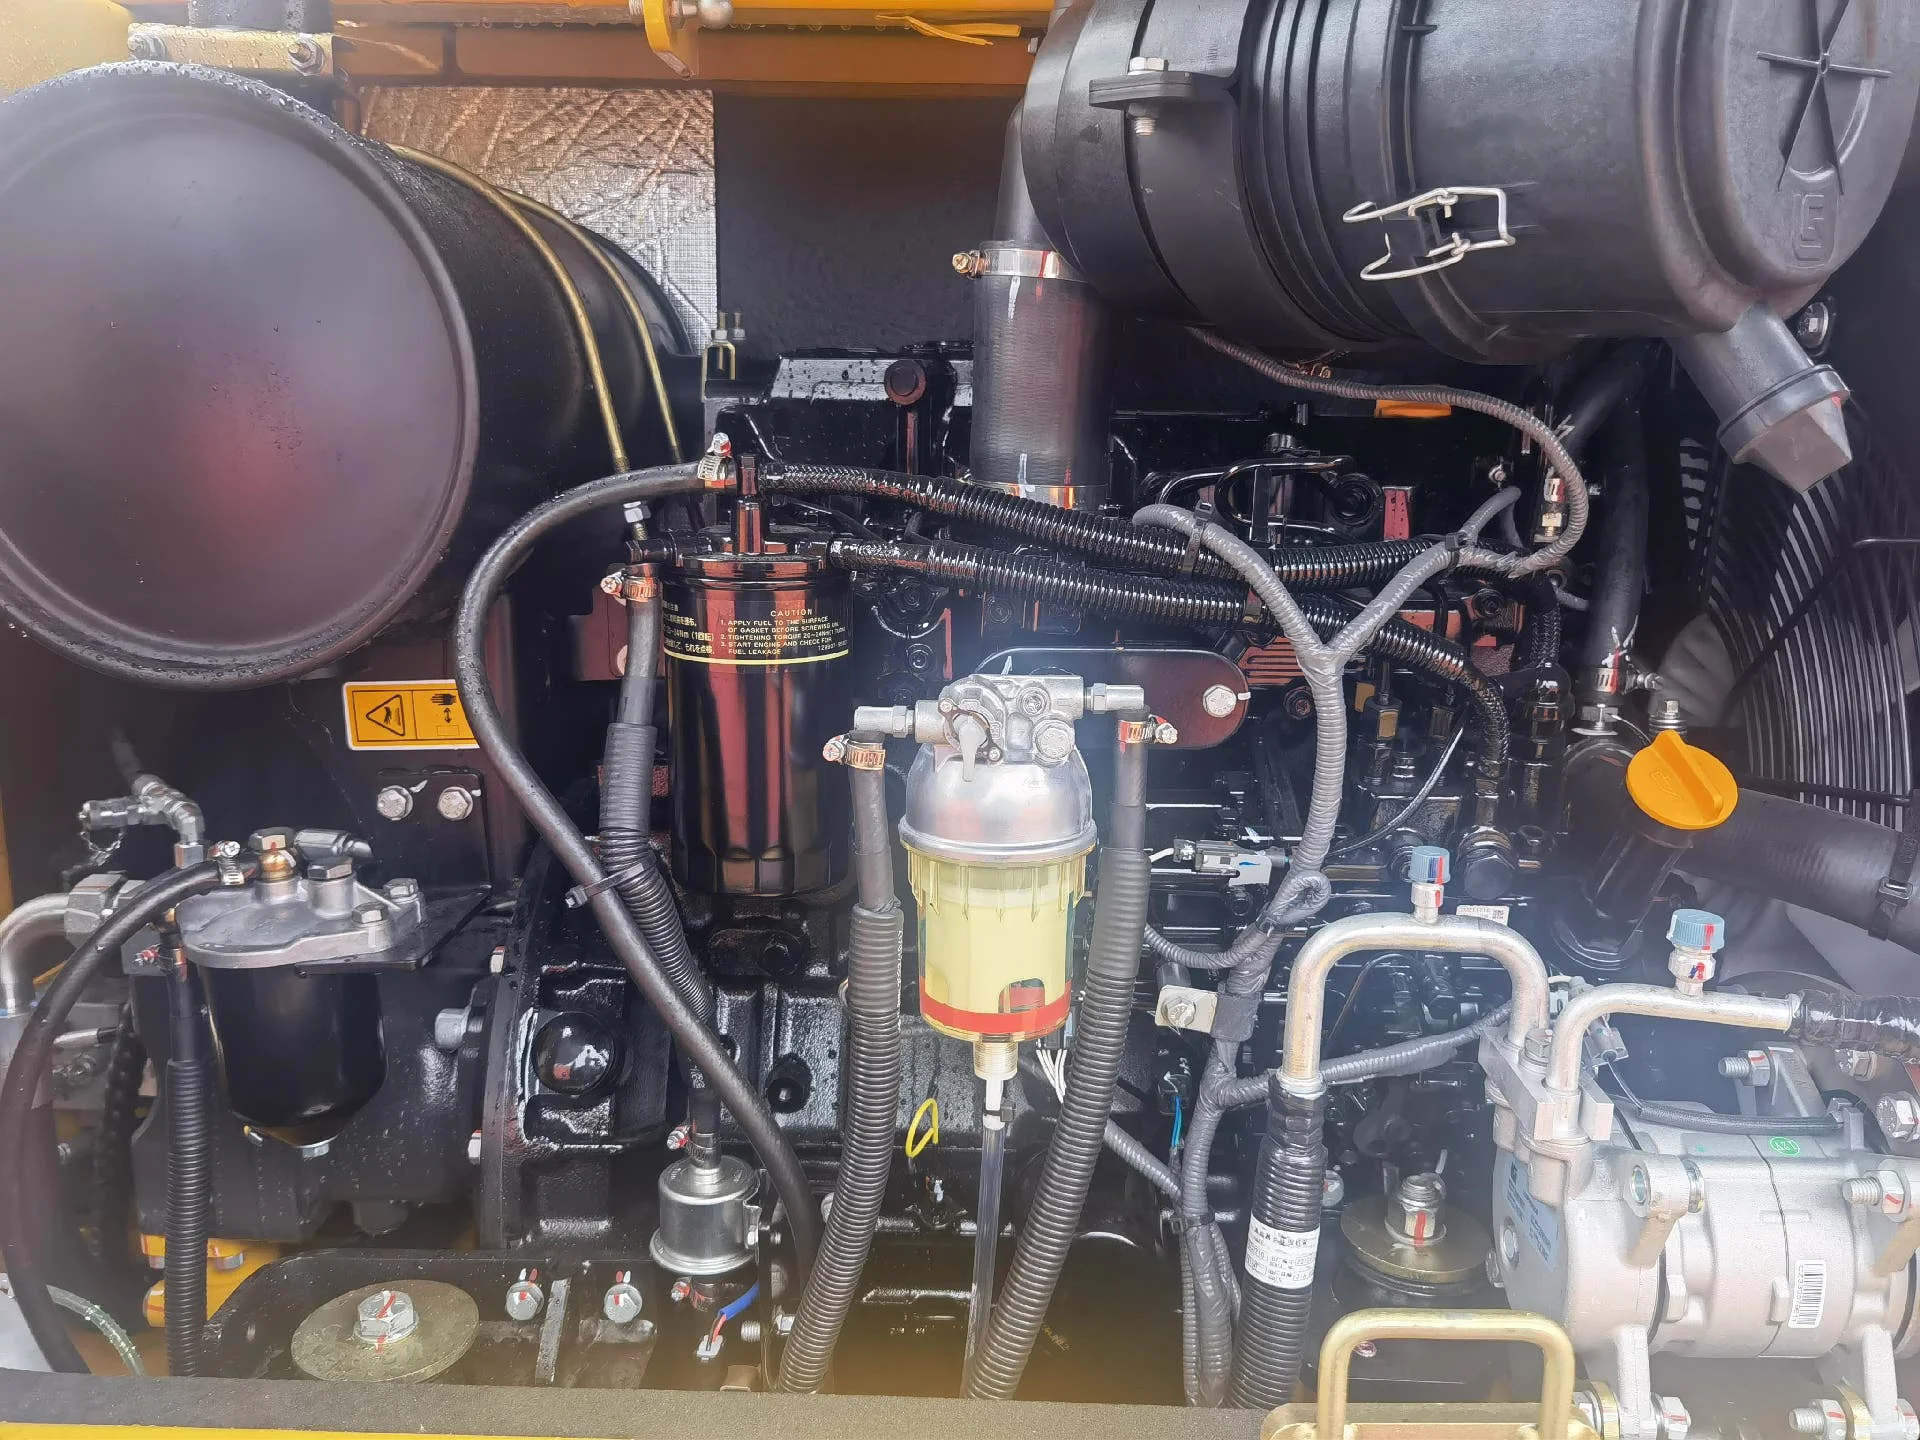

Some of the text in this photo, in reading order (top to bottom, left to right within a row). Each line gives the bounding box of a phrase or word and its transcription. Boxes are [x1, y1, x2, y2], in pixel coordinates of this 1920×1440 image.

[770, 608, 813, 617] CAUTION
[801, 615, 829, 624] SURFACE
[801, 622, 831, 632] SCREWING
